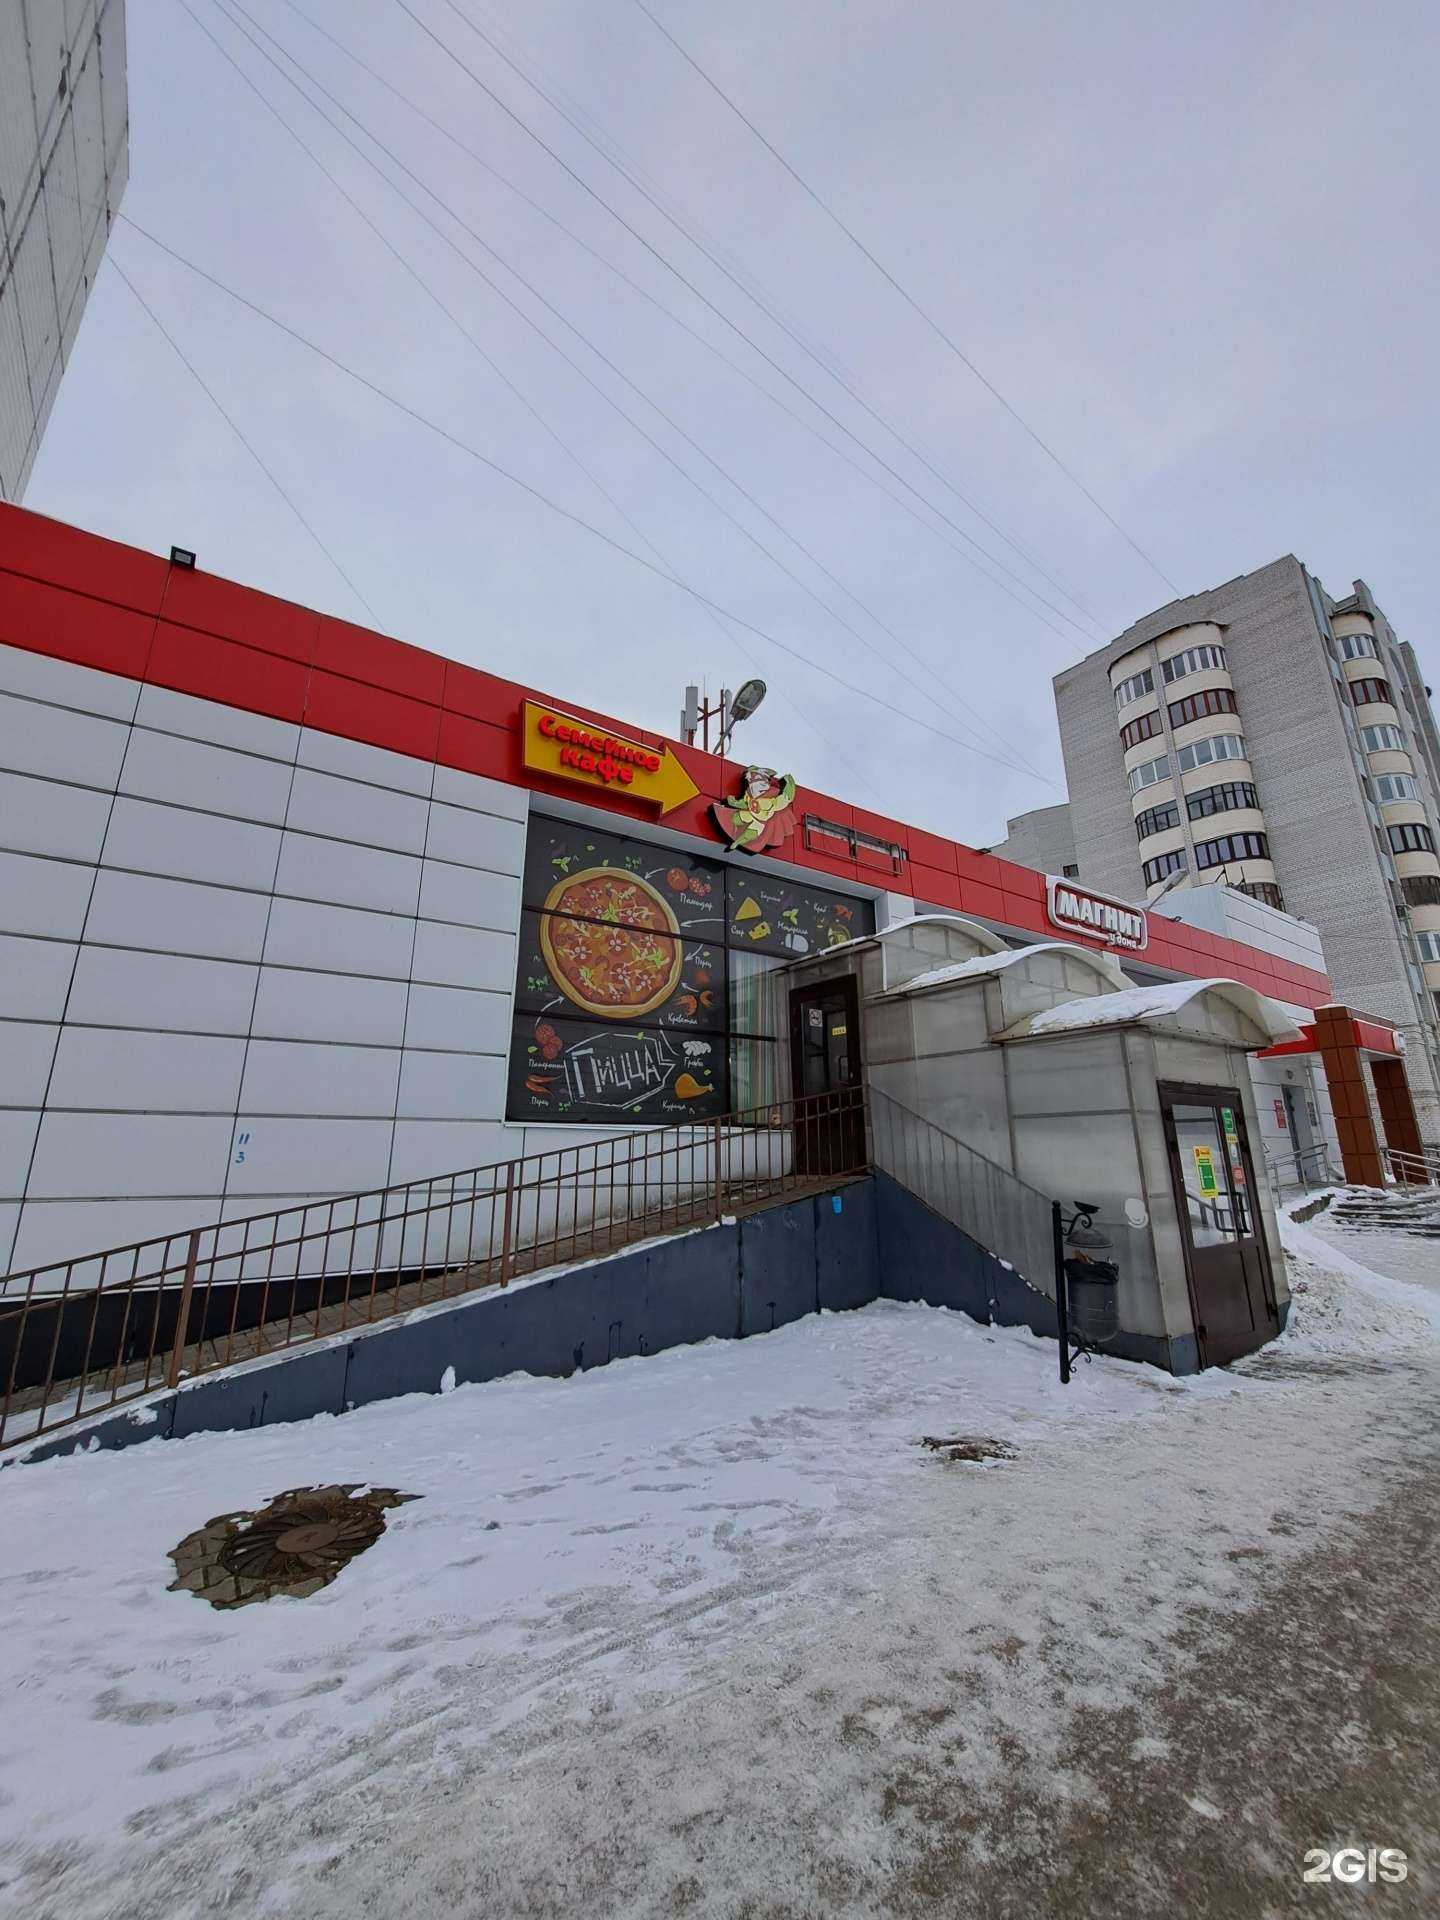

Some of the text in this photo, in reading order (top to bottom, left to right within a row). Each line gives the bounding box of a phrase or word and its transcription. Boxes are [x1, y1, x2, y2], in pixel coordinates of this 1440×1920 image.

[538, 714, 661, 773] Семейное
[559, 746, 634, 784] кафе
[1056, 888, 1142, 939] МАГНИТ
[730, 925, 745, 937] Сыр
[1115, 931, 1138, 949] дома
[695, 956, 712, 968] Перец
[531, 1095, 549, 1107] Перец
